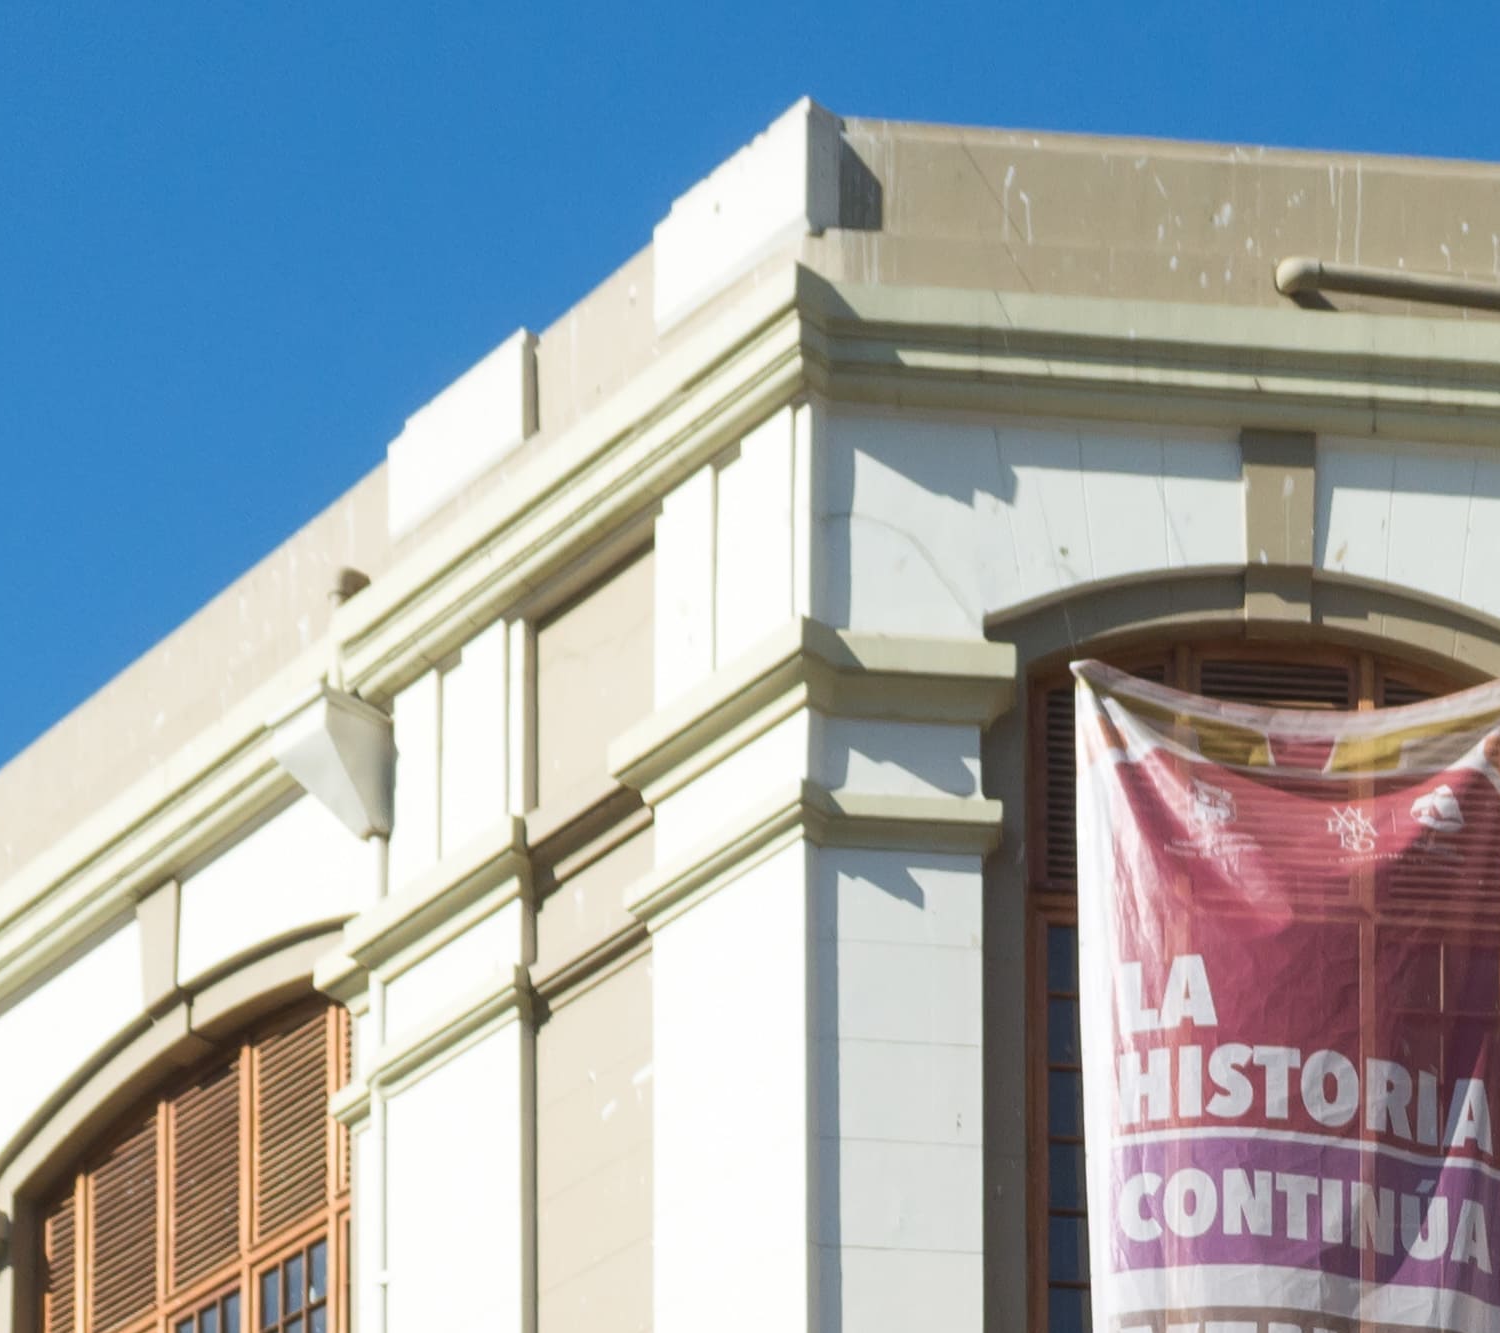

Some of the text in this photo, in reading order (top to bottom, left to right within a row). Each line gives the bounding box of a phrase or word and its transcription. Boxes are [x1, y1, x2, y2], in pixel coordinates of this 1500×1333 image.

[1118, 953, 1218, 1031] LA
[1118, 1043, 1493, 1158] HISTORIA
[1118, 1164, 1493, 1275] CONTINÚA
